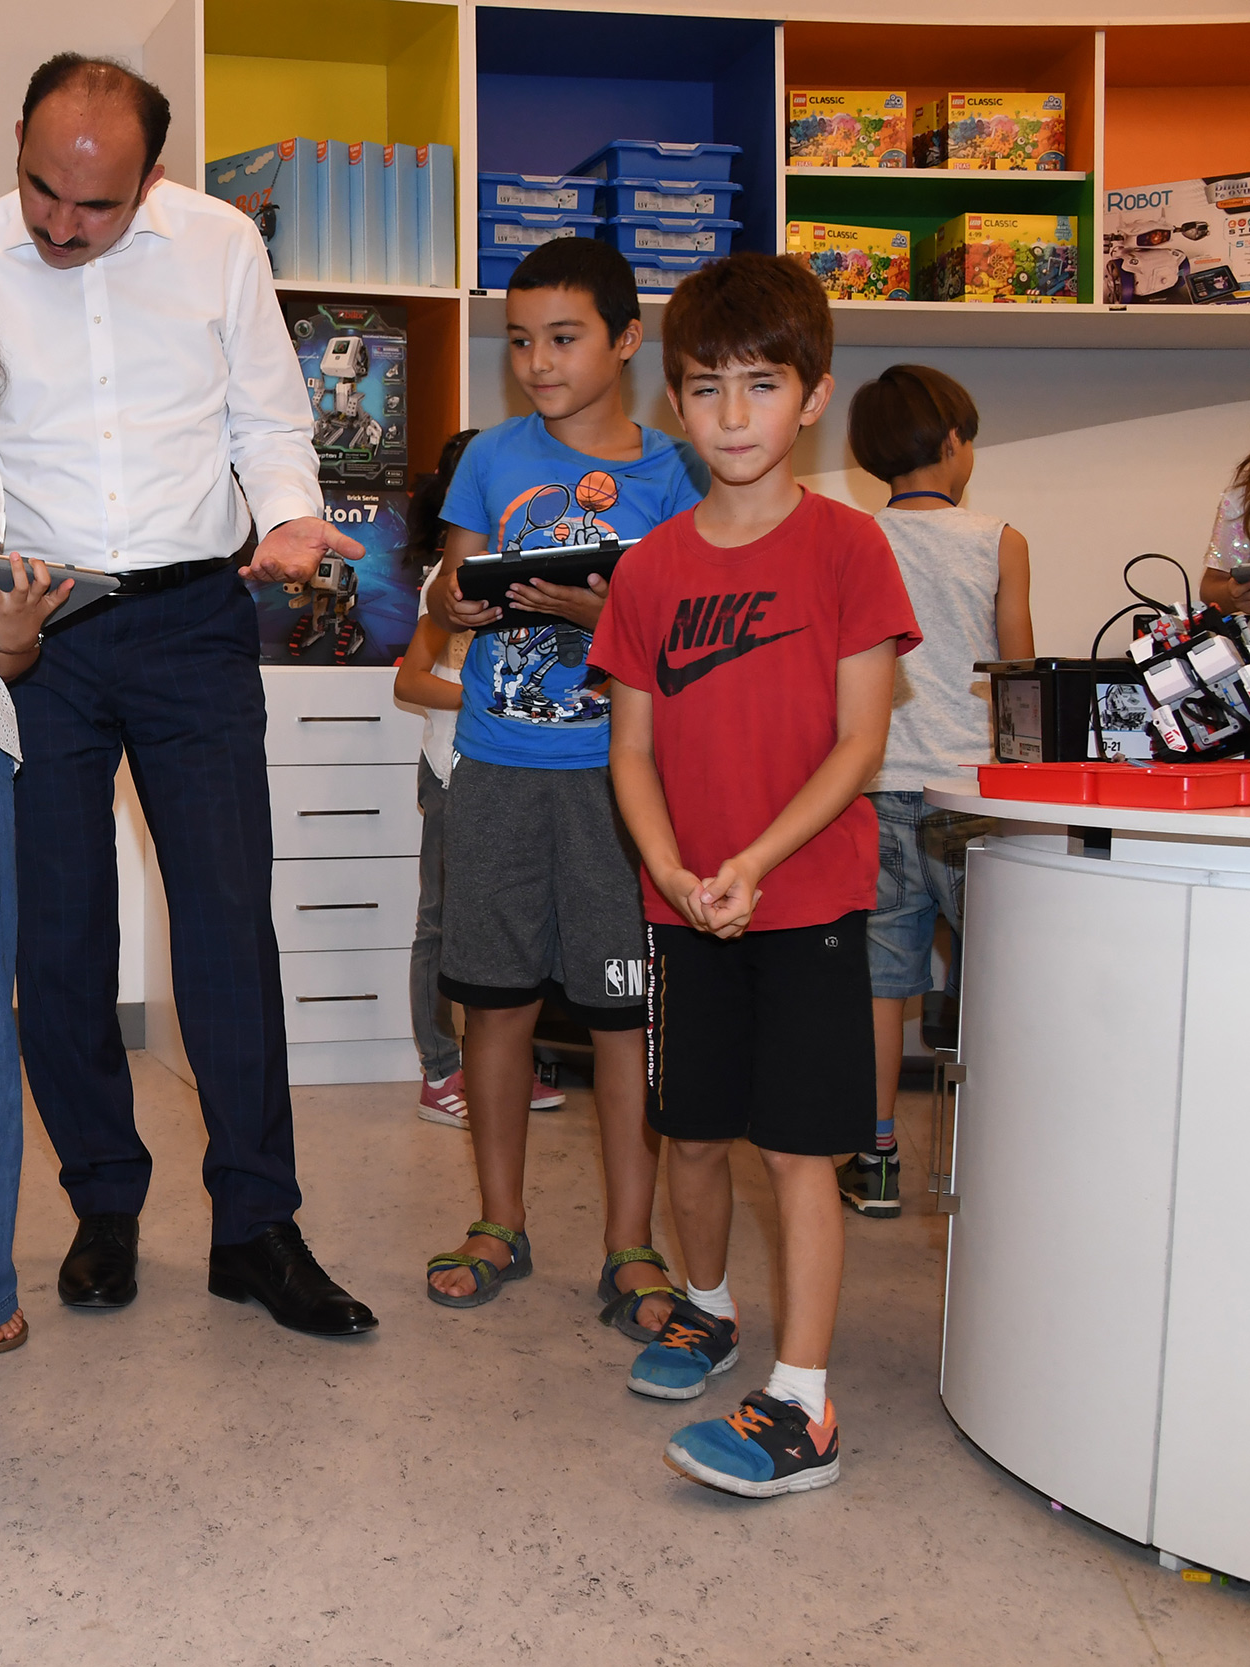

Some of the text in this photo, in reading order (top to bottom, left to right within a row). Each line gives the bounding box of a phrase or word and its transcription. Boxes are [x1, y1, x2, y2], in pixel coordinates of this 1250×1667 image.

[809, 96, 845, 104] CLASSIC
[967, 98, 1003, 106] CLASSIC
[1107, 190, 1173, 212] ROBOT
[984, 219, 1018, 228] CLASSIC
[827, 230, 858, 240] CLASSIC
[364, 504, 378, 522] 7
[668, 591, 777, 652] NIKE
[646, 924, 655, 958] ATMOS
